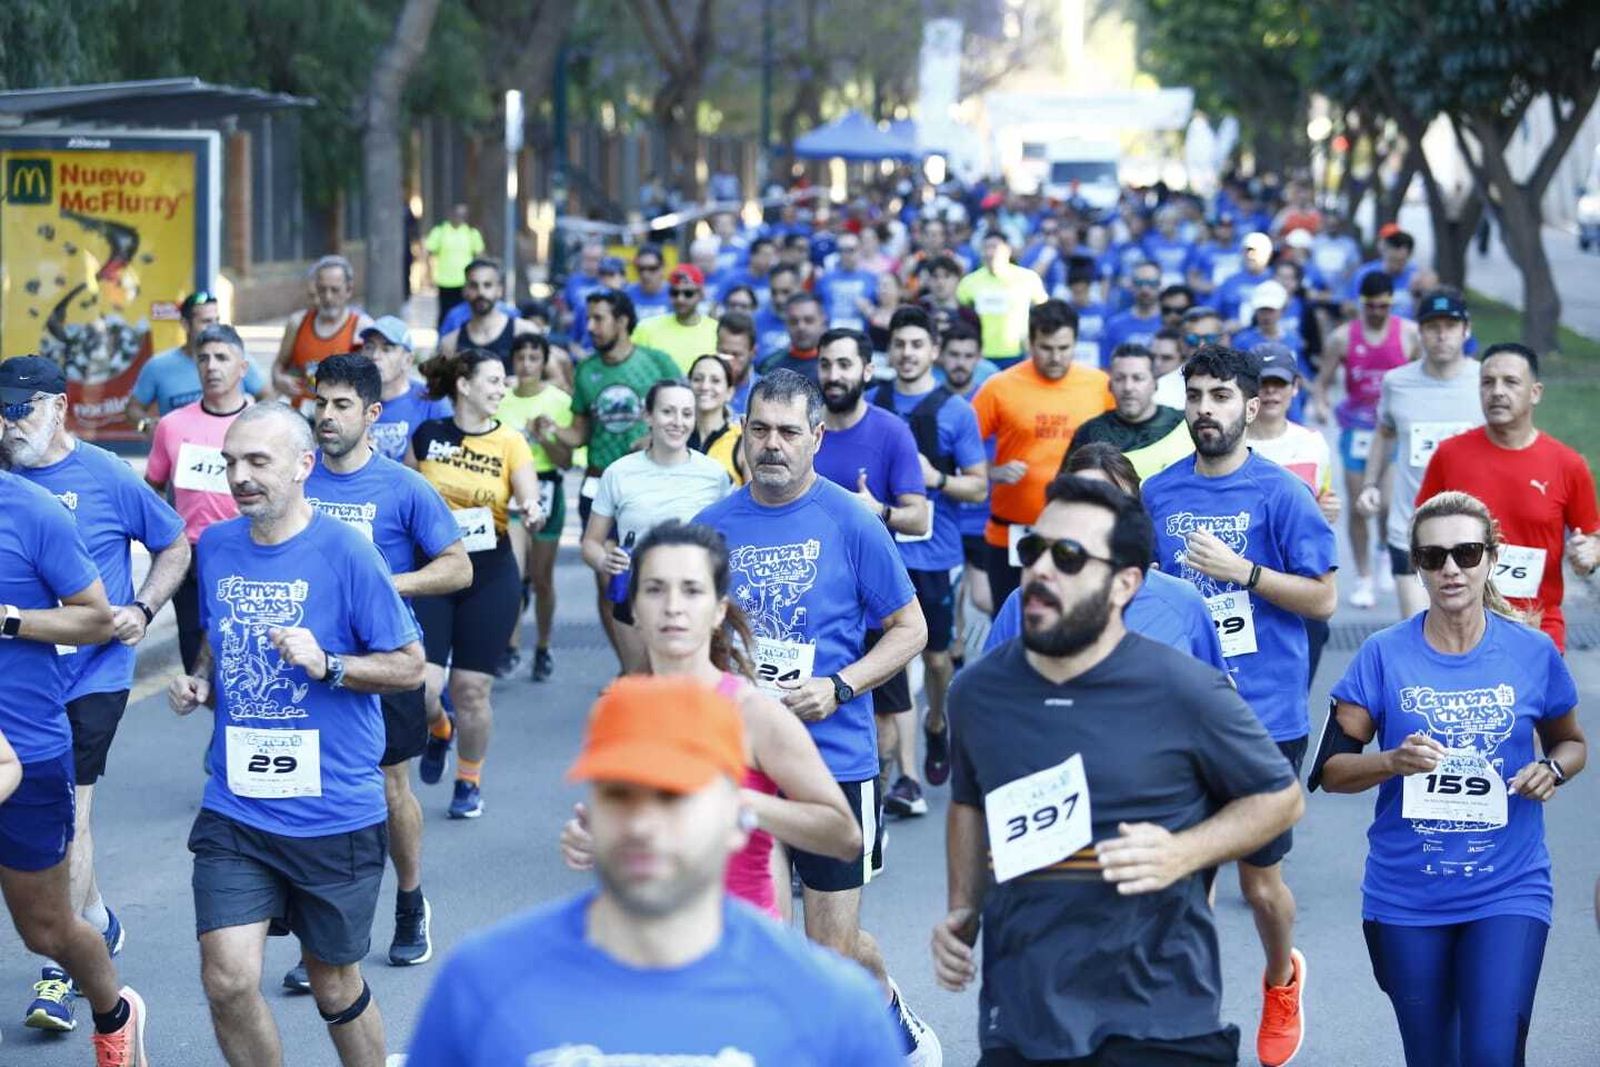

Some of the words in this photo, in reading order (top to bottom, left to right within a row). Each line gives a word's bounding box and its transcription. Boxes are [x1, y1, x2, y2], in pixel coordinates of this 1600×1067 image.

[60, 164, 145, 186] Nuevo
[60, 190, 178, 220] McFlurry
[427, 439, 503, 468] bichos
[1415, 684, 1498, 710] Carrera
[1432, 704, 1507, 724] Prensa
[248, 754, 298, 774] 29
[1425, 774, 1491, 796] 159
[1005, 792, 1079, 843] 397
